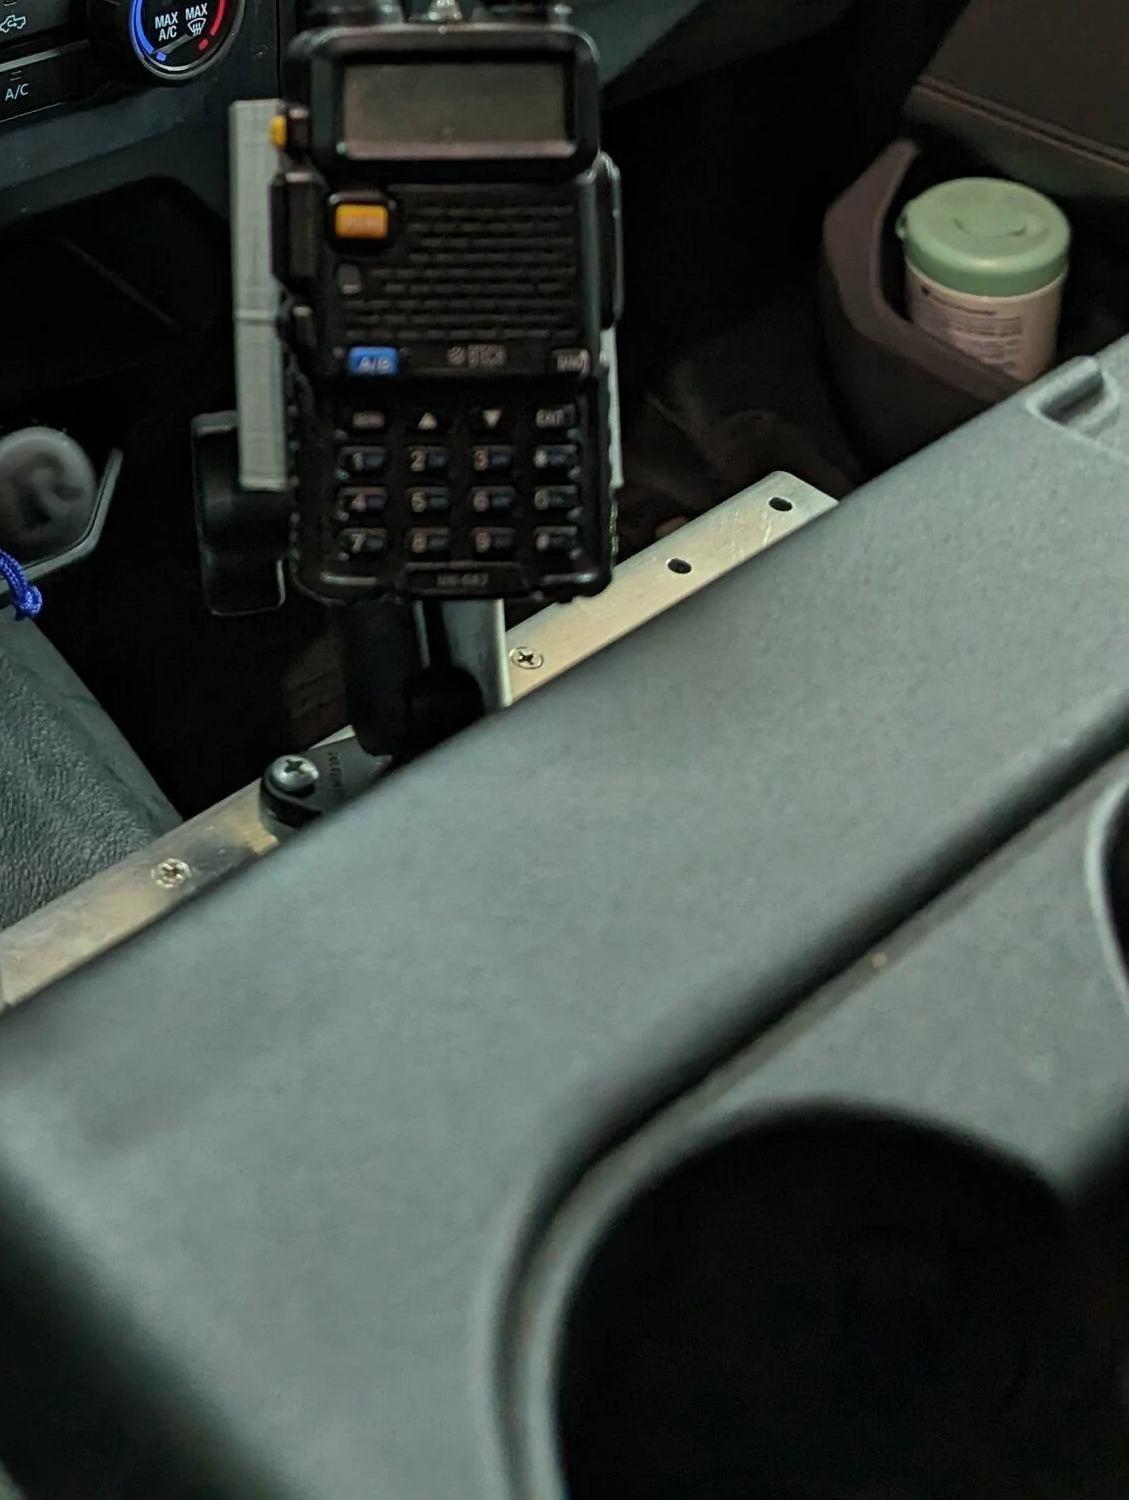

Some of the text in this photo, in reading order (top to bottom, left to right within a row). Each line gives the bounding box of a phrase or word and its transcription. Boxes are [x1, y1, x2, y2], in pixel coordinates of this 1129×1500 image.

[154, 11, 179, 29] MAX
[185, 2, 209, 21] MAX
[158, 25, 178, 42] A/C
[4, 83, 30, 102] A/C
[410, 450, 427, 472] 2
[350, 532, 368, 552] 7
